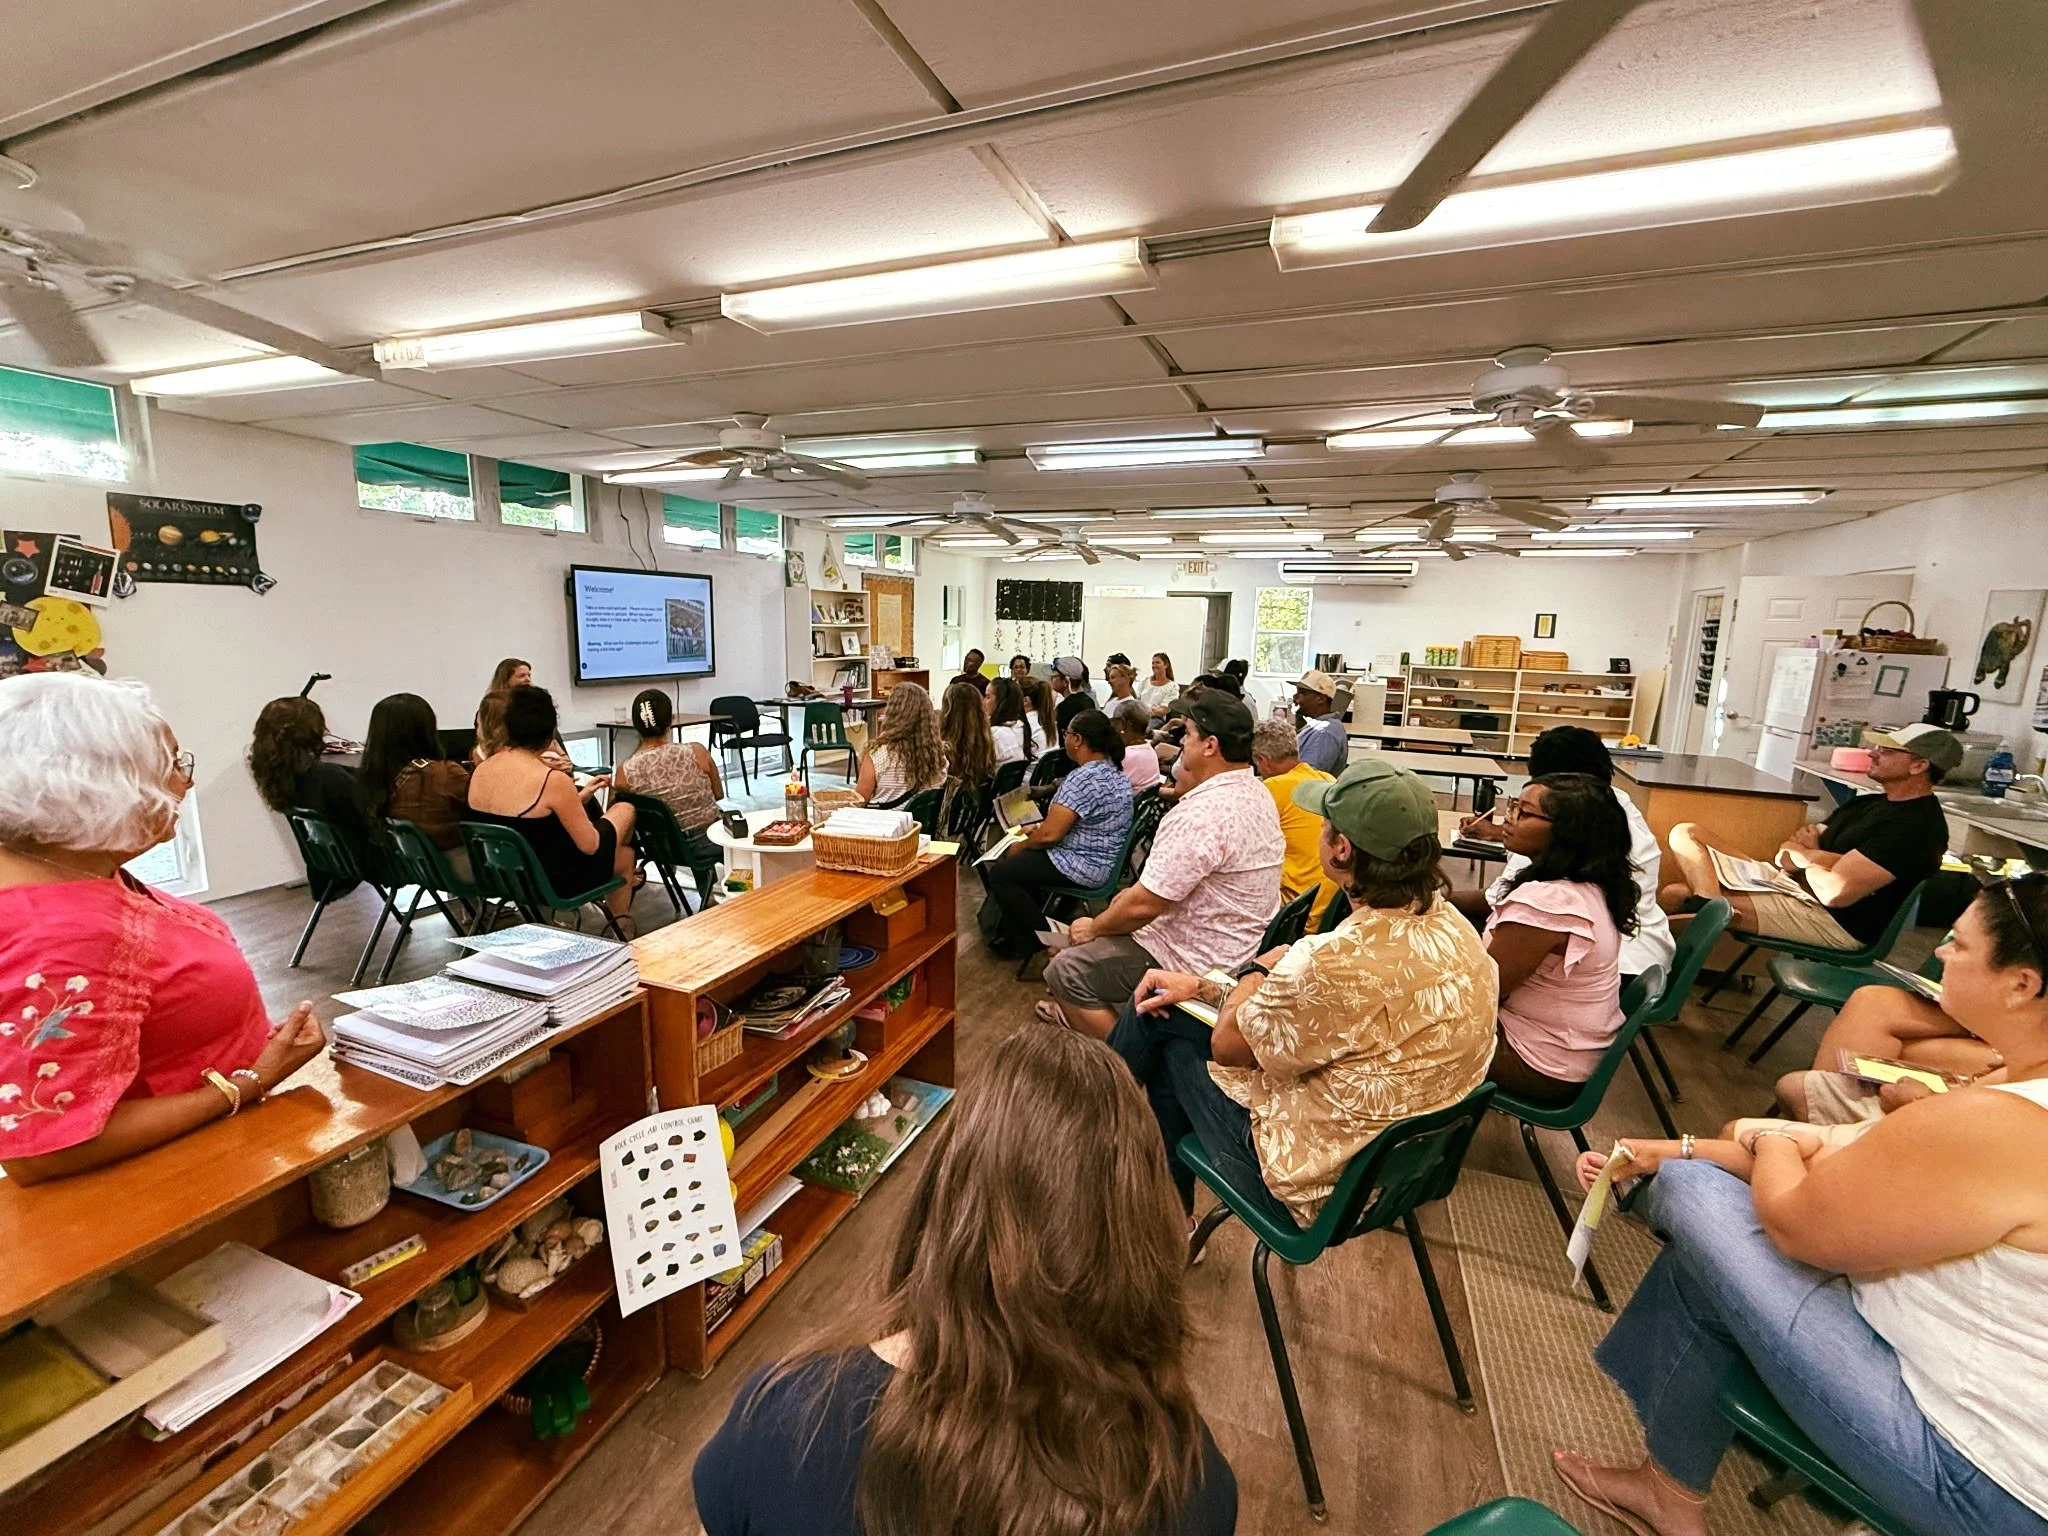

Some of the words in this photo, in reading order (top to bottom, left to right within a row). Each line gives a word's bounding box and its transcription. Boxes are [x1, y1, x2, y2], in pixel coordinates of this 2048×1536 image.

[138, 498, 180, 512] SOLAR
[181, 503, 225, 516] SYSTEM
[1188, 561, 1204, 574] EXIT
[614, 1138, 628, 1152] ROCK
[629, 1130, 645, 1143] CYCLE
[660, 1119, 685, 1131] CONTROL
[687, 1115, 703, 1126] CHART
